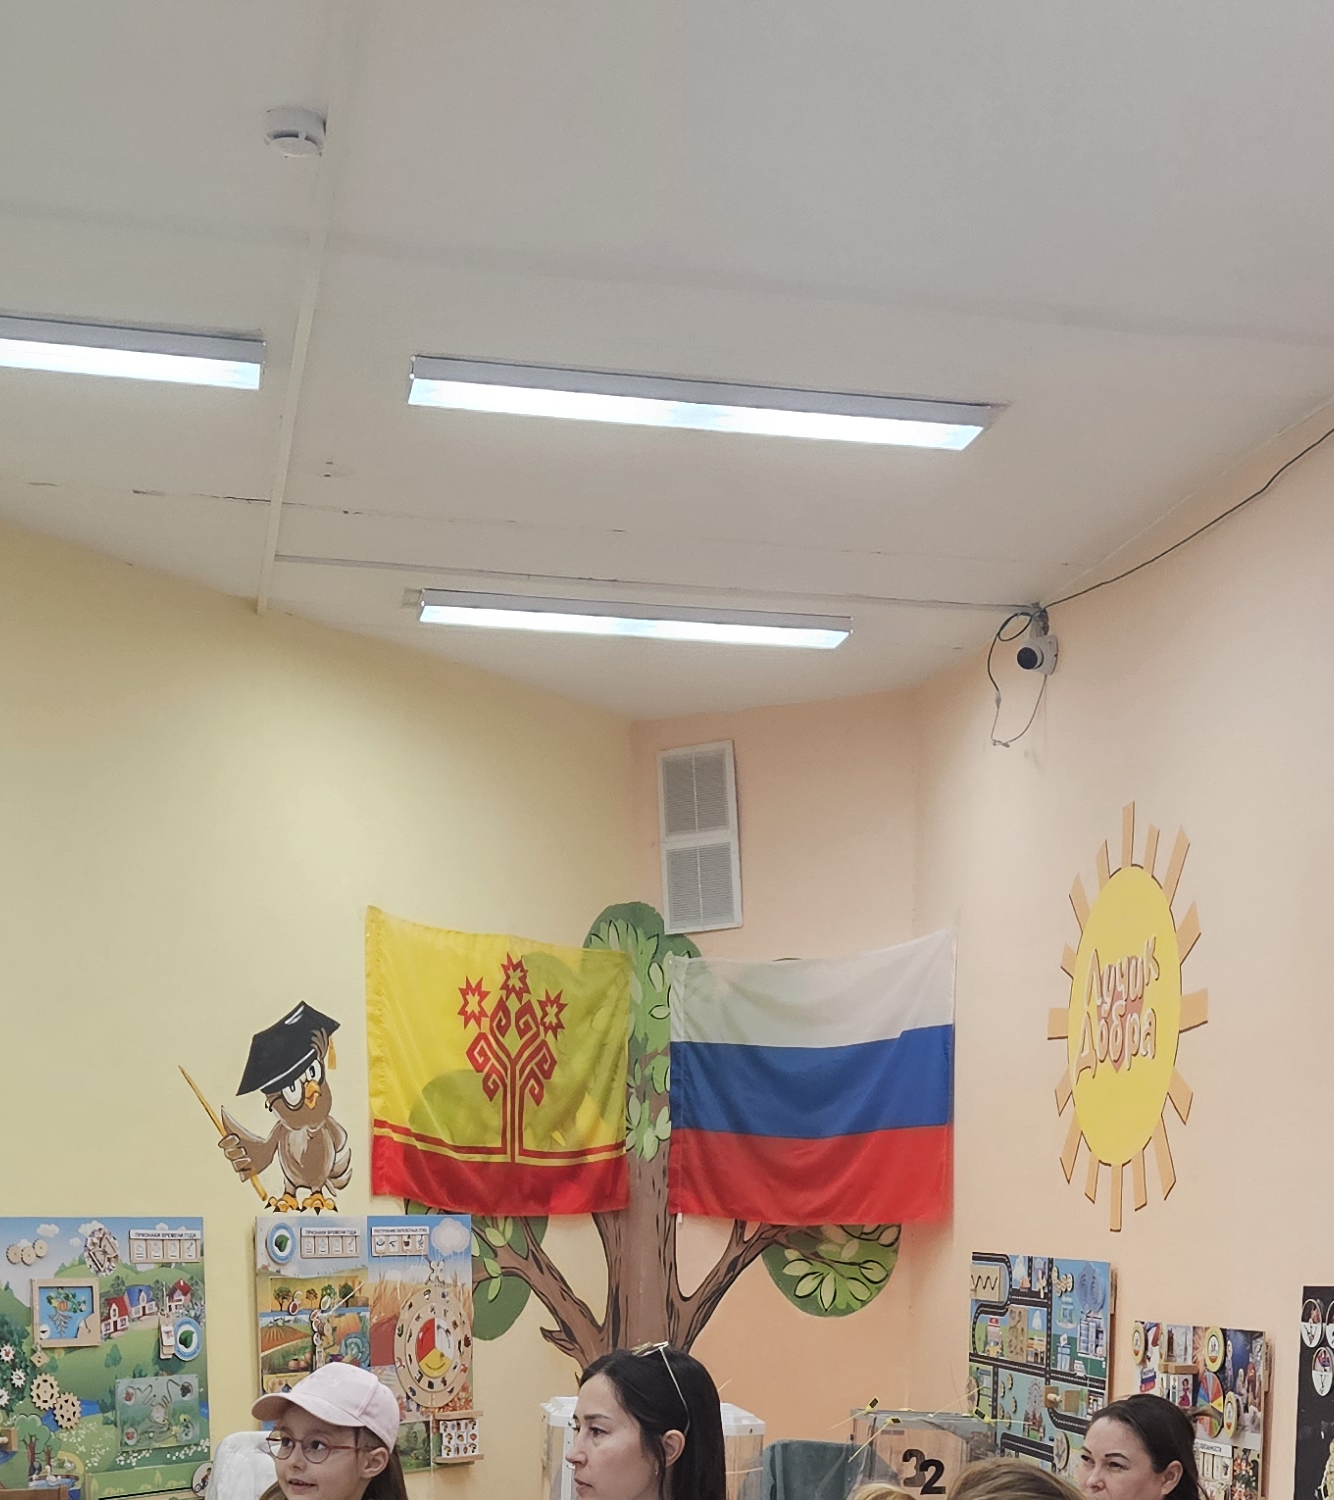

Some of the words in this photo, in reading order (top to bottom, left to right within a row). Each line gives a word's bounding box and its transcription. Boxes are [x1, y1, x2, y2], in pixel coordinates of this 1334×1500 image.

[1085, 935, 1161, 1019] Лучик
[1074, 999, 1156, 1086] Добра
[919, 1459, 947, 1495] 2
